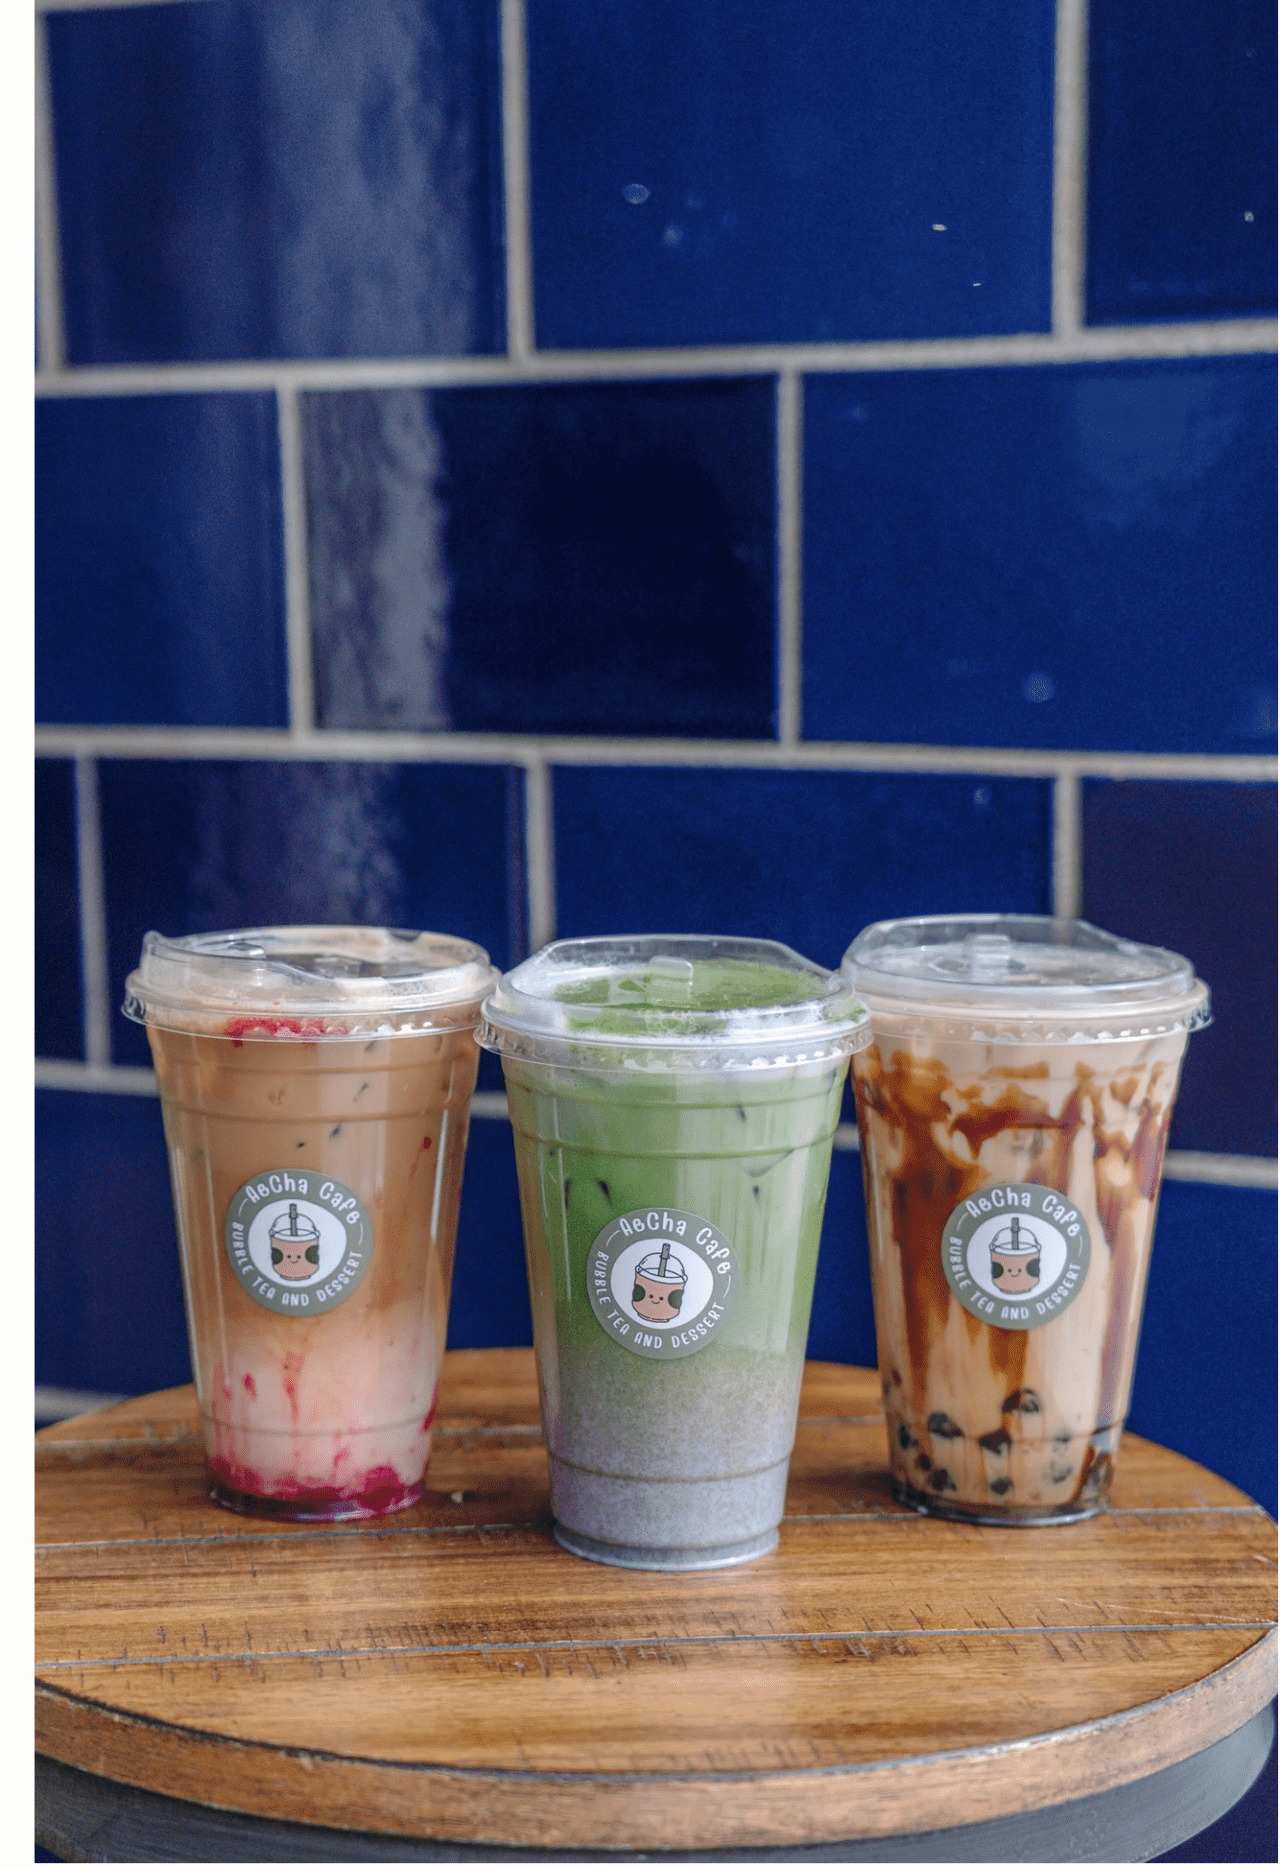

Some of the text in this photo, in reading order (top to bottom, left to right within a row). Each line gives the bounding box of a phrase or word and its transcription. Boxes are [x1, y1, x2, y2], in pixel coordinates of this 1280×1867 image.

[245, 1172, 361, 1224] AeCha Cafe
[965, 1186, 1081, 1237] AeCha Cafe
[232, 1221, 362, 1307] BUBBLE TEA AND DESSERT
[619, 1211, 732, 1275] AeCha Cafe
[949, 1236, 1081, 1320] BUBBLE TEA AND DESSERT
[594, 1250, 725, 1349] BUBBLE TEA AND DESSERT
